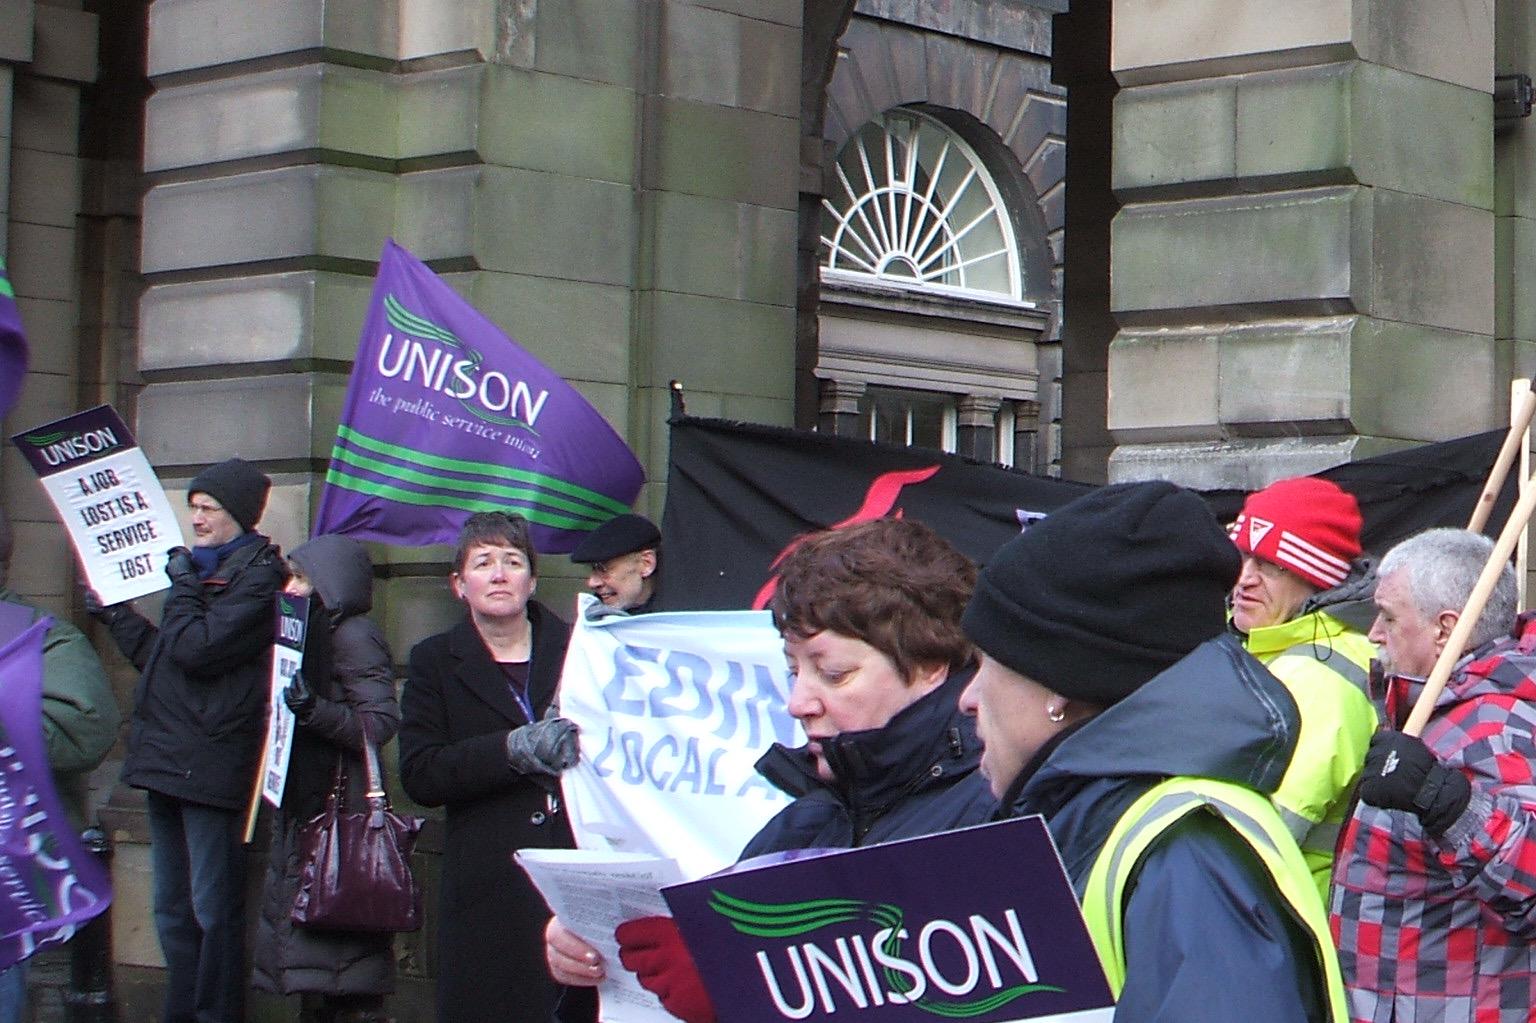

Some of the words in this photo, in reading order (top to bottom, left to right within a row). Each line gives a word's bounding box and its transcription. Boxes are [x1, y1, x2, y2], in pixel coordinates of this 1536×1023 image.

[378, 333, 549, 427] UNISON
[369, 387, 392, 408] the
[393, 397, 440, 422] public
[442, 414, 503, 441] service
[40, 427, 118, 466] UNISON
[78, 477, 92, 497] A
[90, 469, 121, 493] JOB
[80, 500, 119, 527] LOST
[116, 494, 136, 515] IS
[135, 491, 149, 511] A
[96, 520, 158, 554] SERVICE
[119, 553, 154, 580] LOST
[593, 727, 729, 796] LOCAL
[757, 908, 1039, 1020] UNISON
